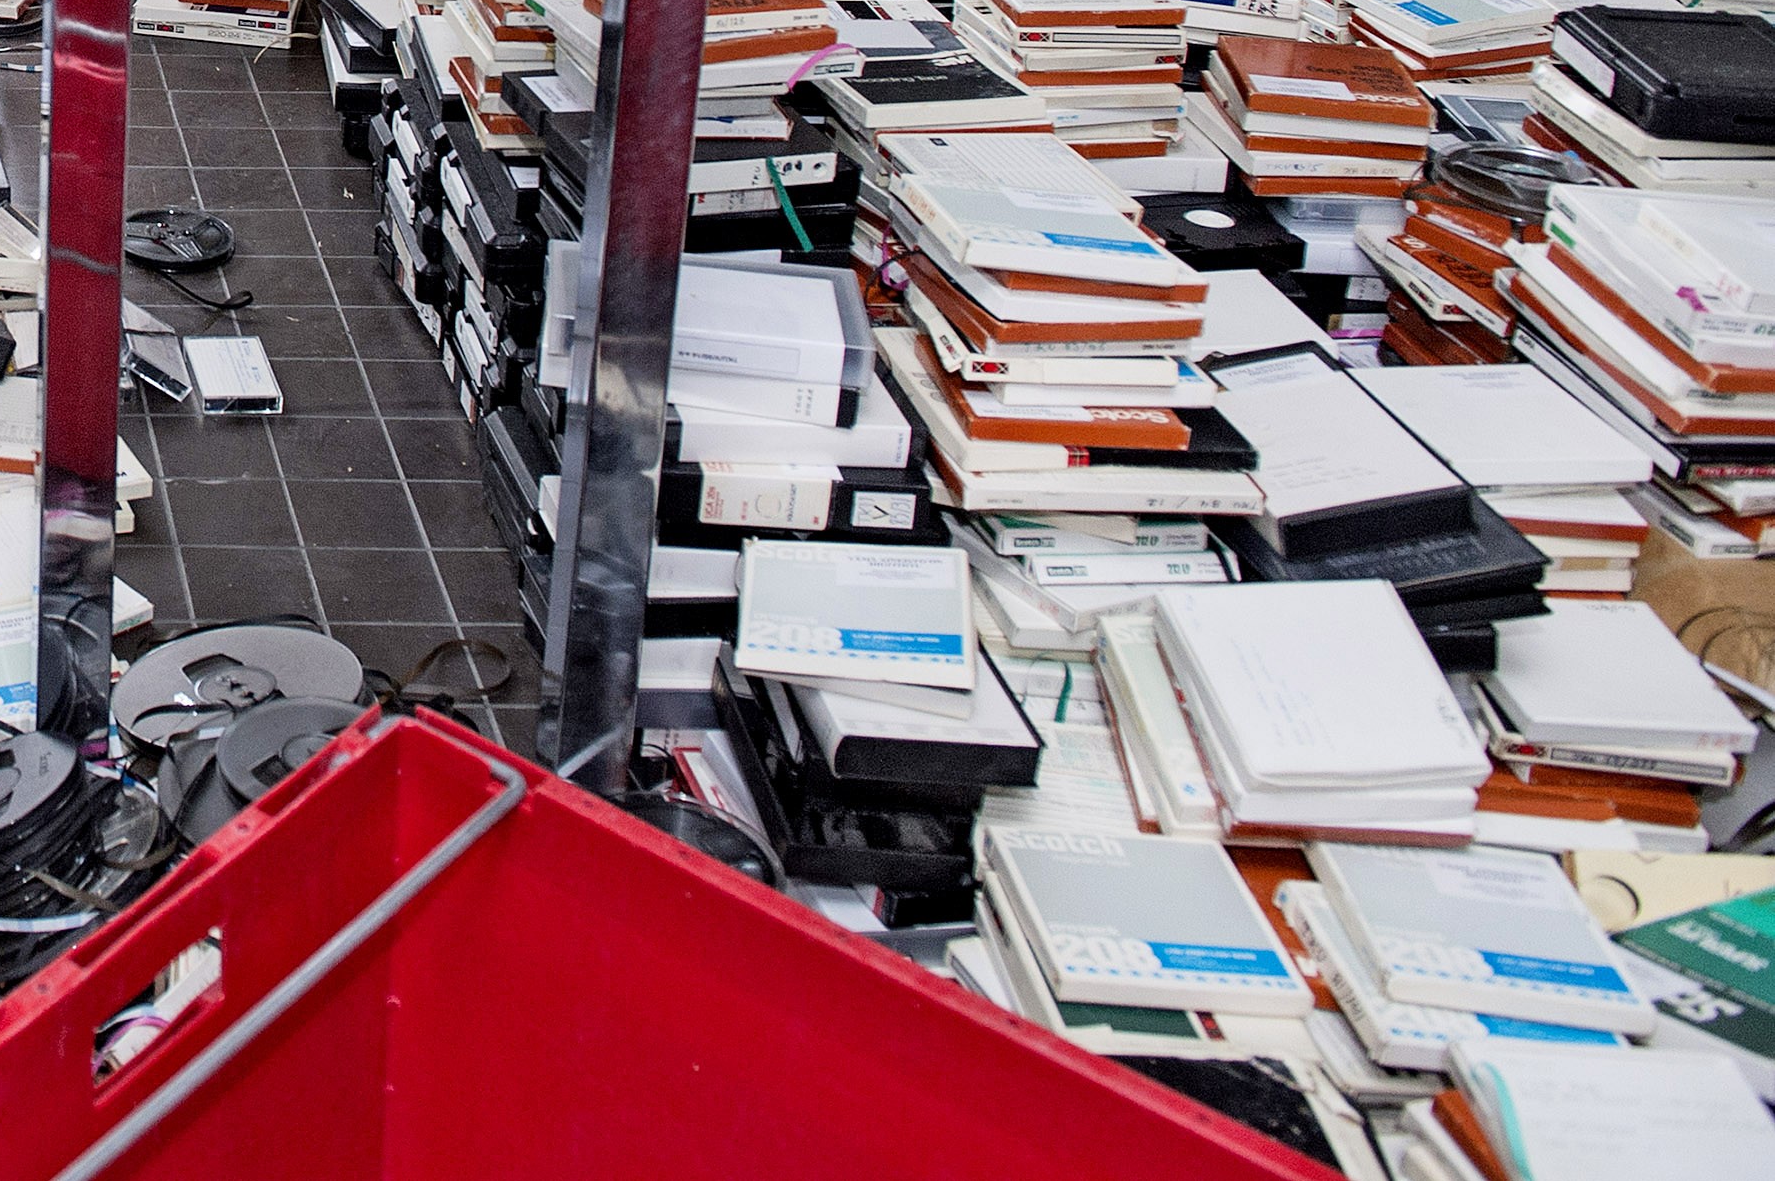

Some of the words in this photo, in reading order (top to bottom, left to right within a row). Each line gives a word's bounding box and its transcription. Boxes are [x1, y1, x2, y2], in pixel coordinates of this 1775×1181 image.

[1355, 93, 1421, 107] Scotc
[747, 622, 844, 650] 208
[1002, 829, 1125, 858] Scotch
[1050, 932, 1163, 969] 208
